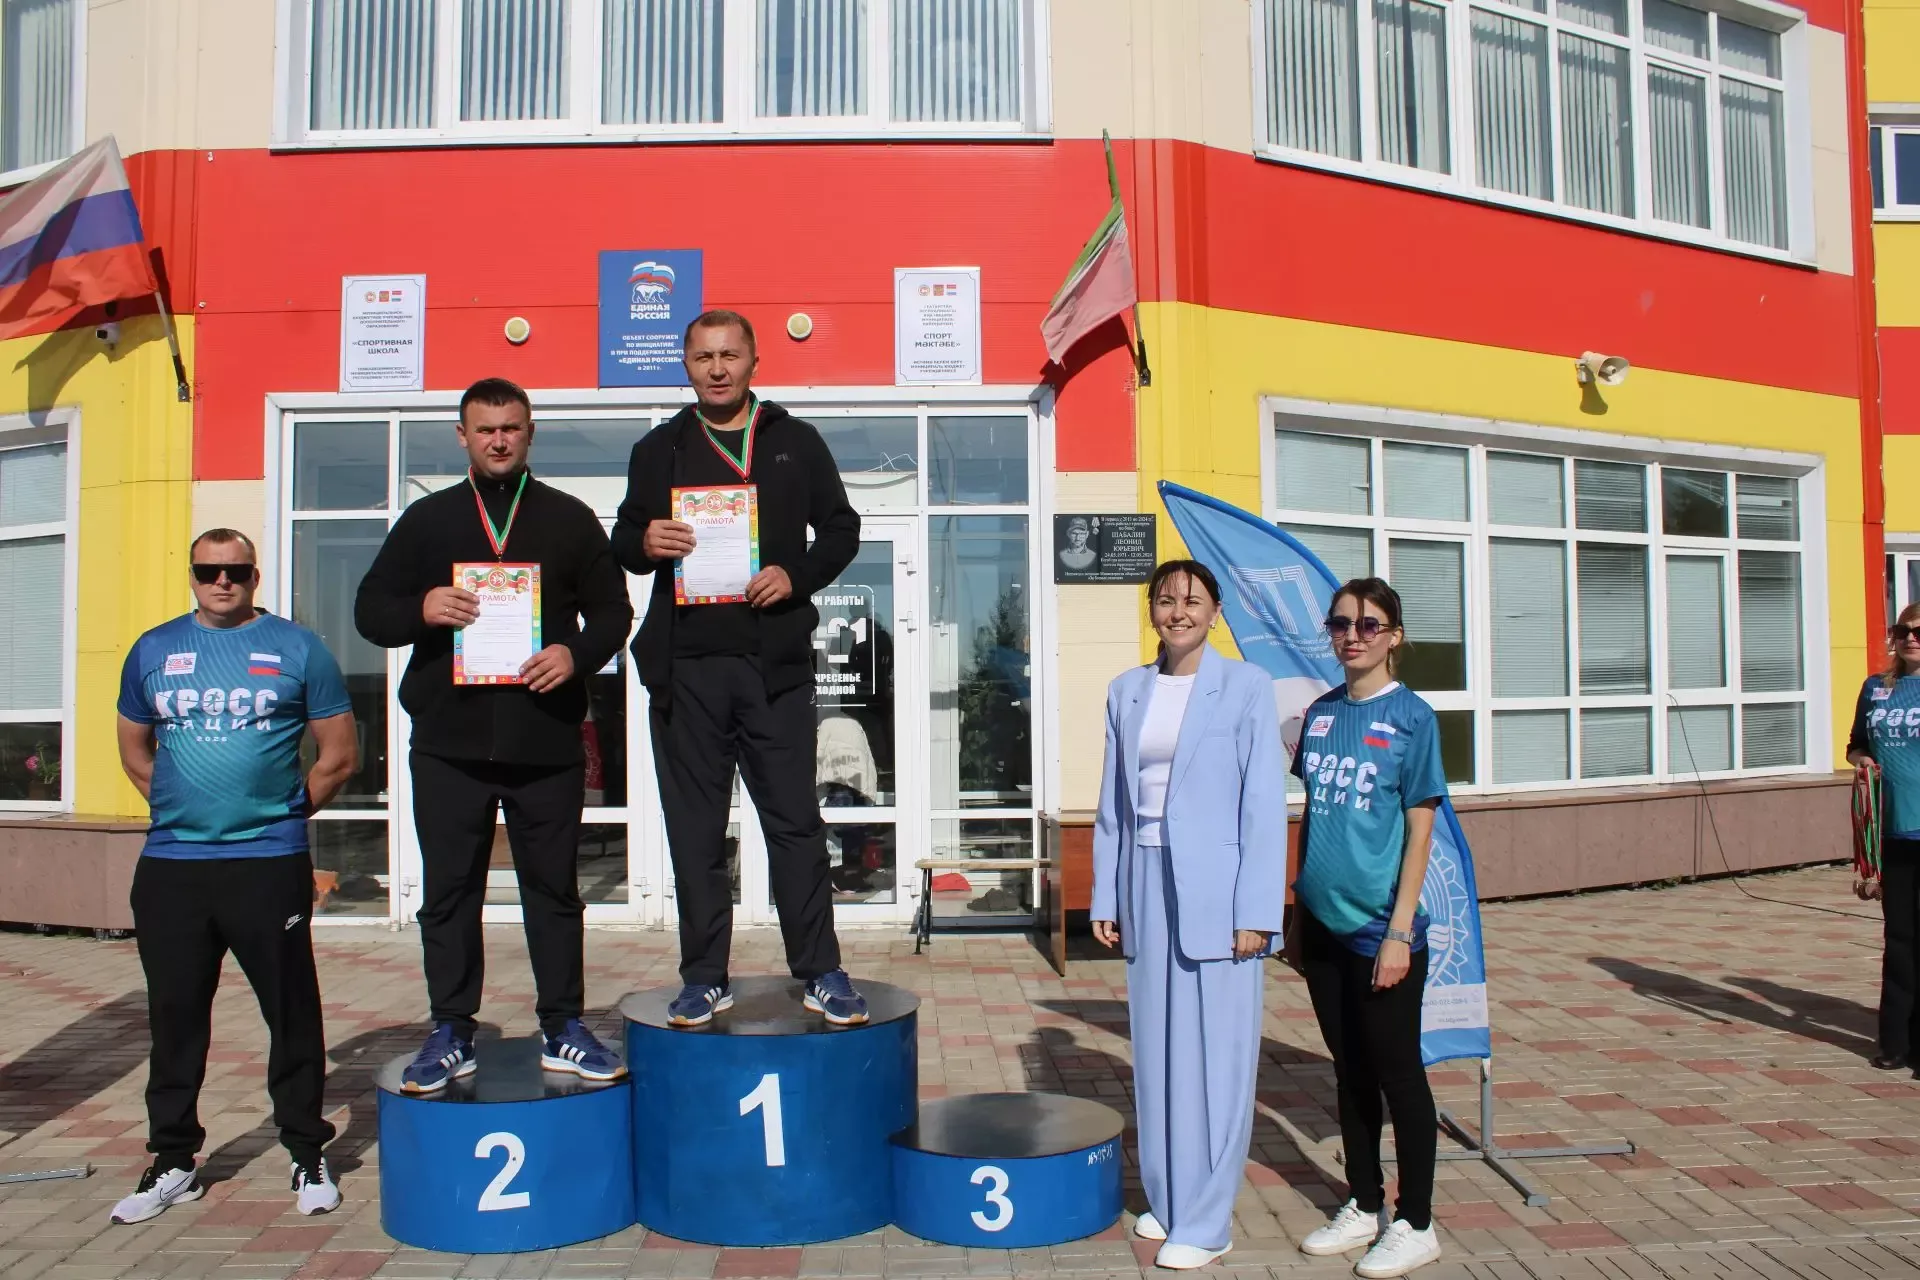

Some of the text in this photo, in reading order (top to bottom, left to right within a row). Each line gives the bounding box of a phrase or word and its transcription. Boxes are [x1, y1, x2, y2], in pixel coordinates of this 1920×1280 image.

[630, 304, 670, 312] ЕДИНАЯ
[630, 312, 670, 320] РОССИЯ
[695, 517, 735, 525] ГРАМОТА
[824, 595, 864, 606] РАБОТЫ
[155, 687, 278, 719] КРОСС
[1303, 752, 1378, 793] РОСС
[740, 1073, 786, 1166] 1
[475, 1131, 530, 1212] 2
[970, 1165, 1014, 1232] 3
